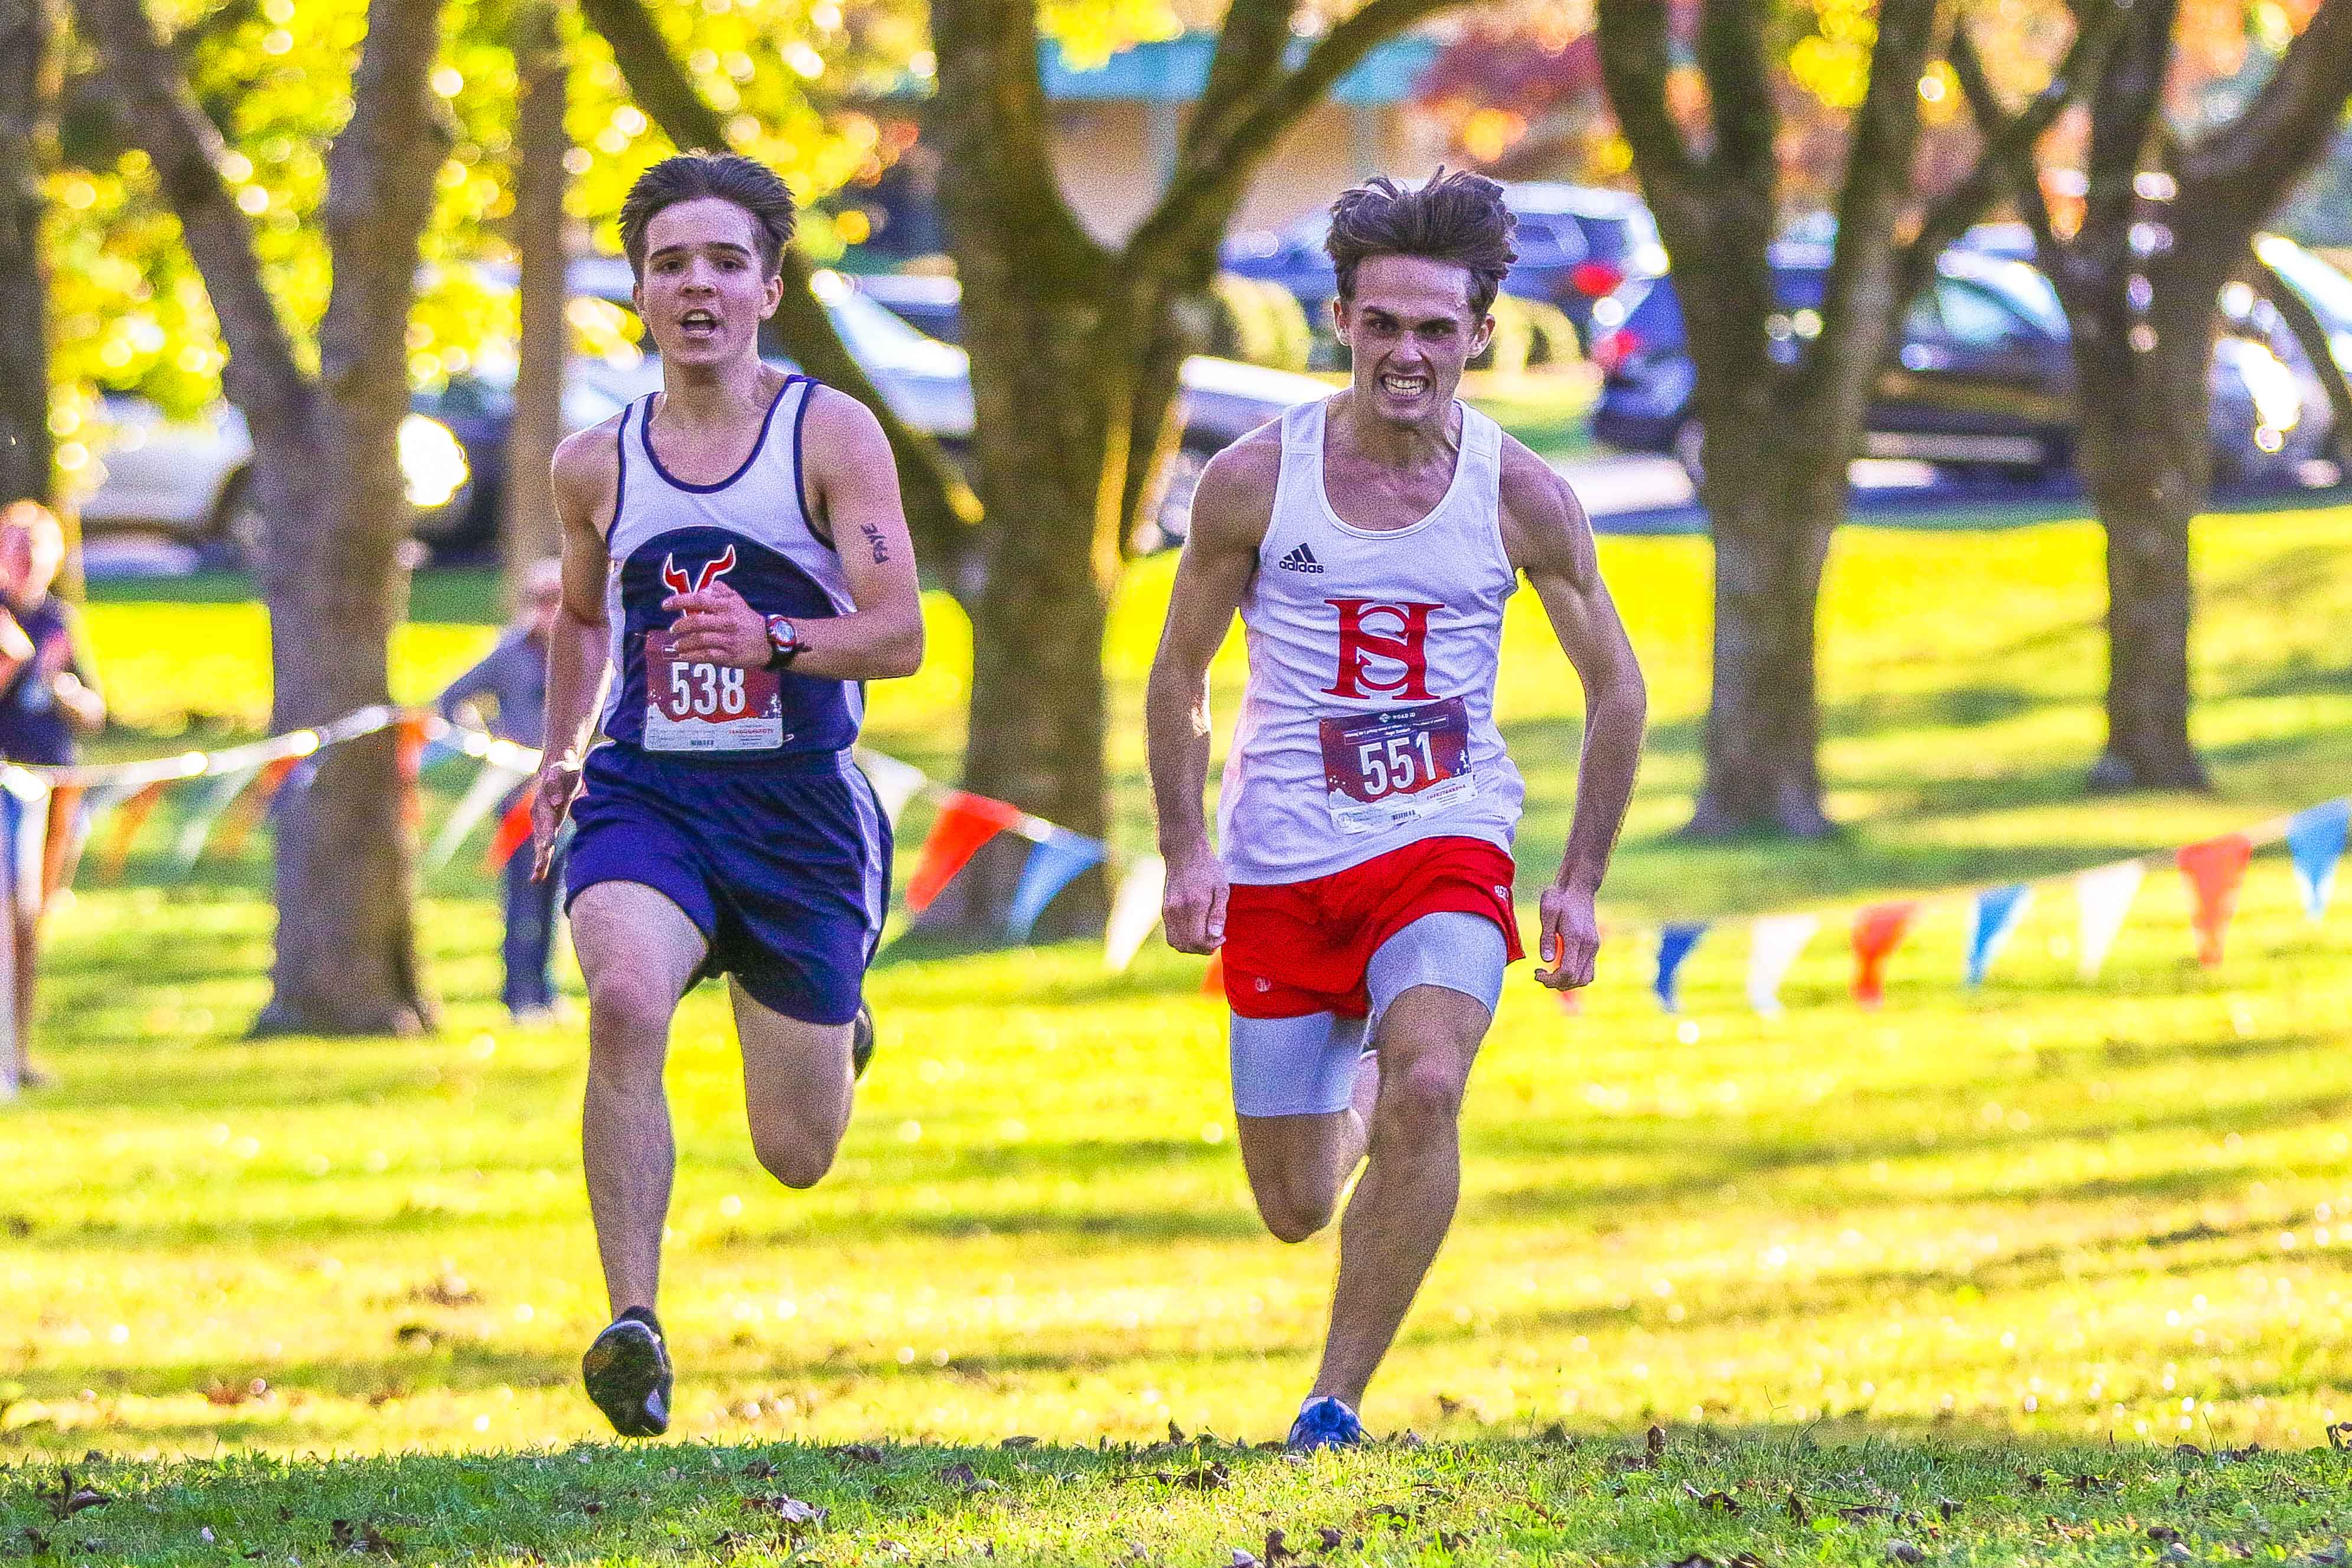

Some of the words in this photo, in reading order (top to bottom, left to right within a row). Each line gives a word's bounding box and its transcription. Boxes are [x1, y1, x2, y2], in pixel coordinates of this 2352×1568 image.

[861, 523, 890, 564] FAYE
[1279, 559, 1324, 573] adidas
[670, 661, 745, 716] 538
[1359, 731, 1437, 796] 551
